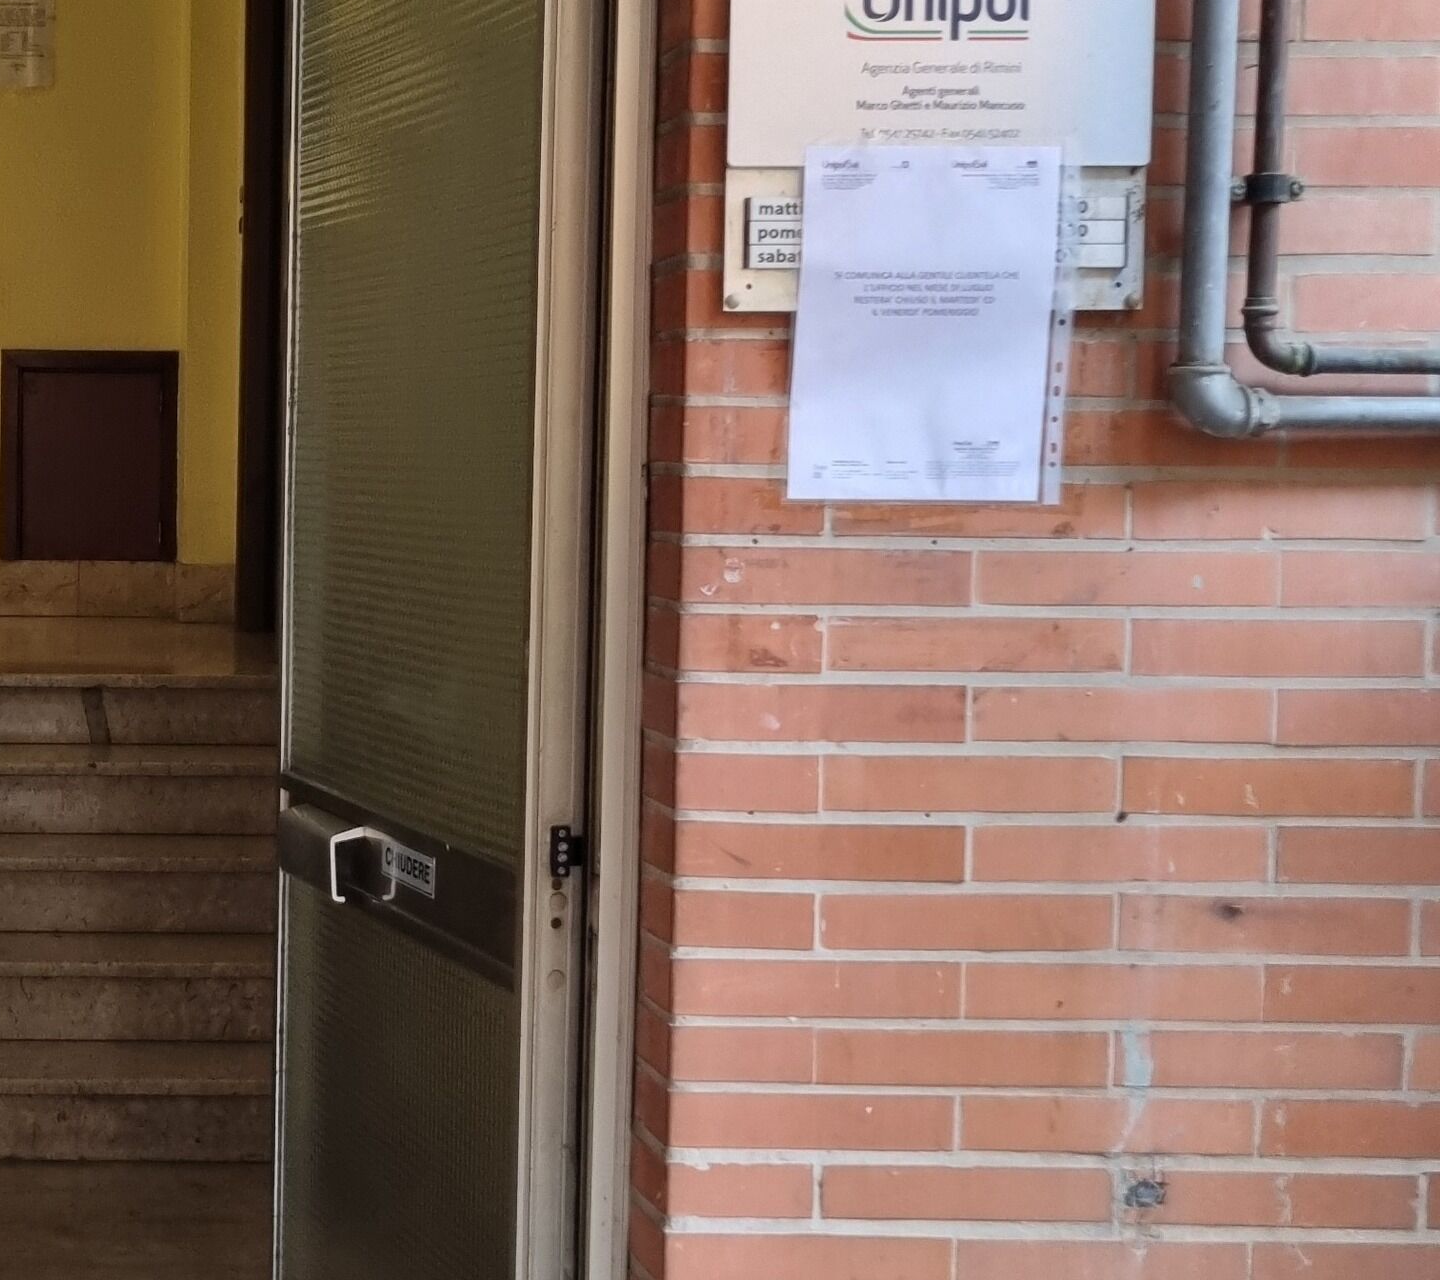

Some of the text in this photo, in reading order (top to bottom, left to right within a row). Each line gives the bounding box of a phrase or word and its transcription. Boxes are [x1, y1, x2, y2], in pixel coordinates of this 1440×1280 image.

[861, 62, 910, 77] Agenzia
[912, 61, 967, 74] Generale
[970, 61, 980, 73] di
[902, 86, 979, 99] Agenti generali
[856, 100, 888, 110] Marco
